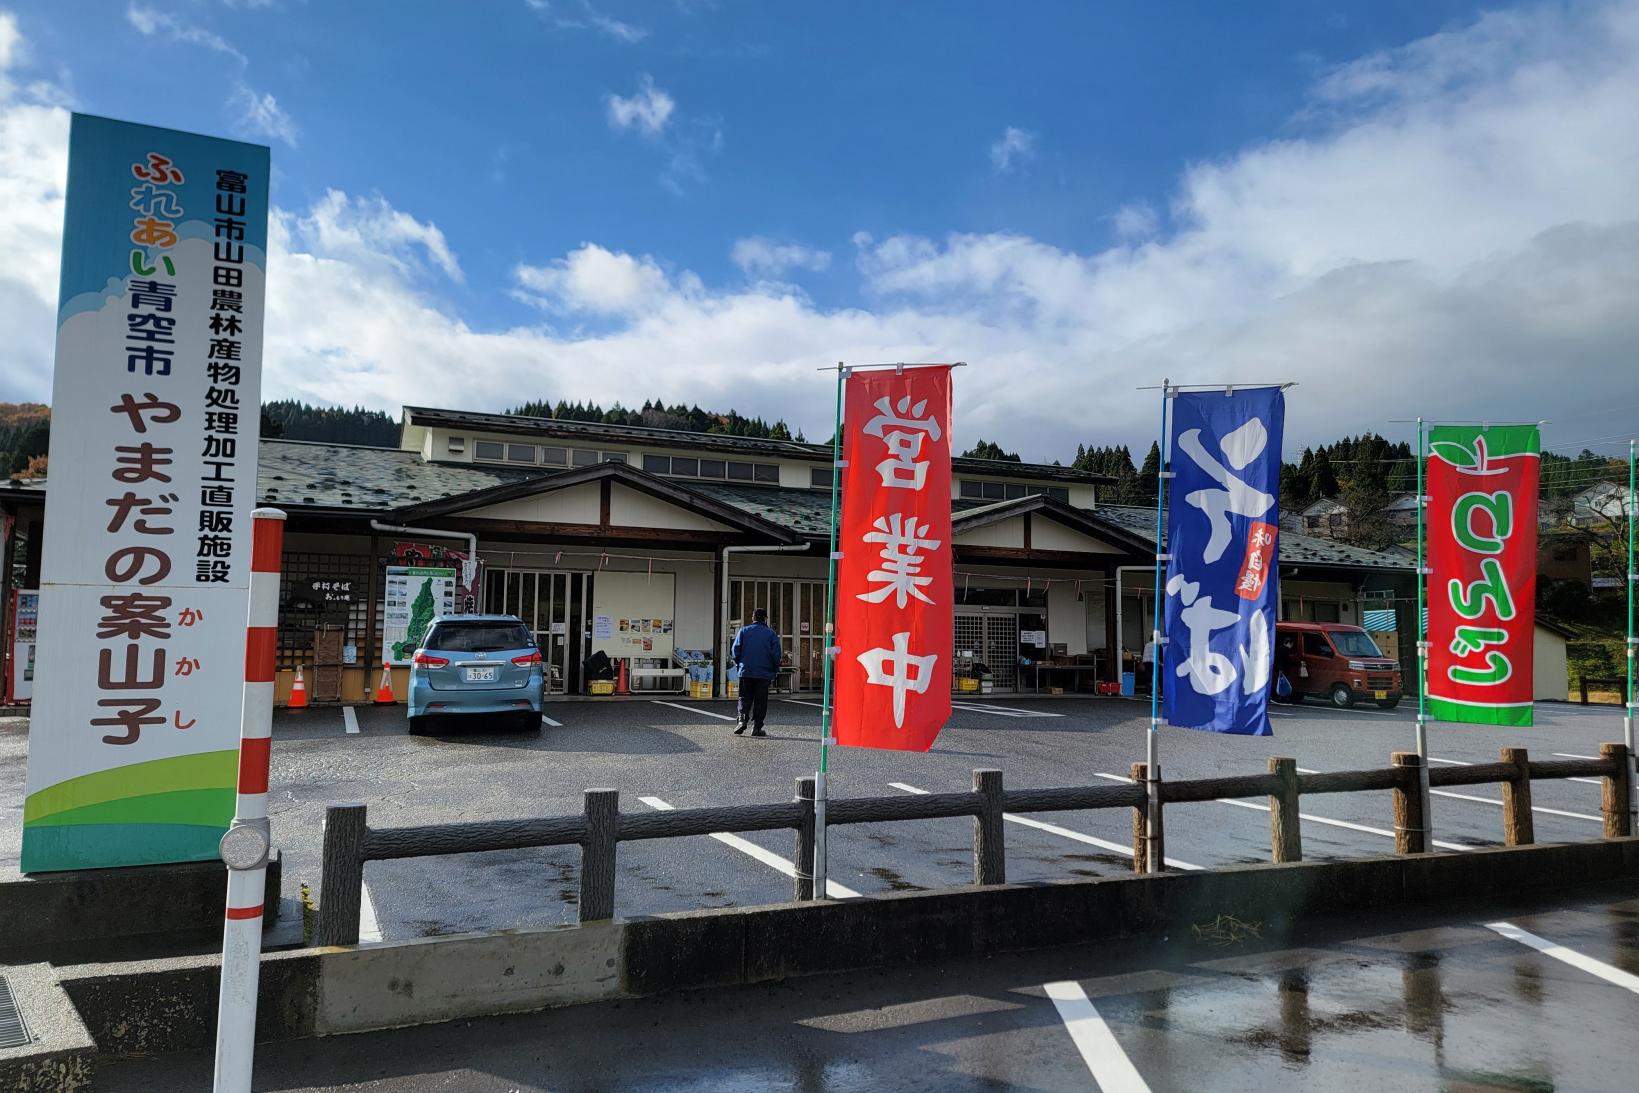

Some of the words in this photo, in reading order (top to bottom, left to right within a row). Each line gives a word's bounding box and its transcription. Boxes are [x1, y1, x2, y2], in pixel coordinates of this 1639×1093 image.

[195, 169, 249, 583] 富山市山田農林産物処理加工直販施設
[174, 607, 204, 730] かかし
[855, 394, 942, 730] 営業中
